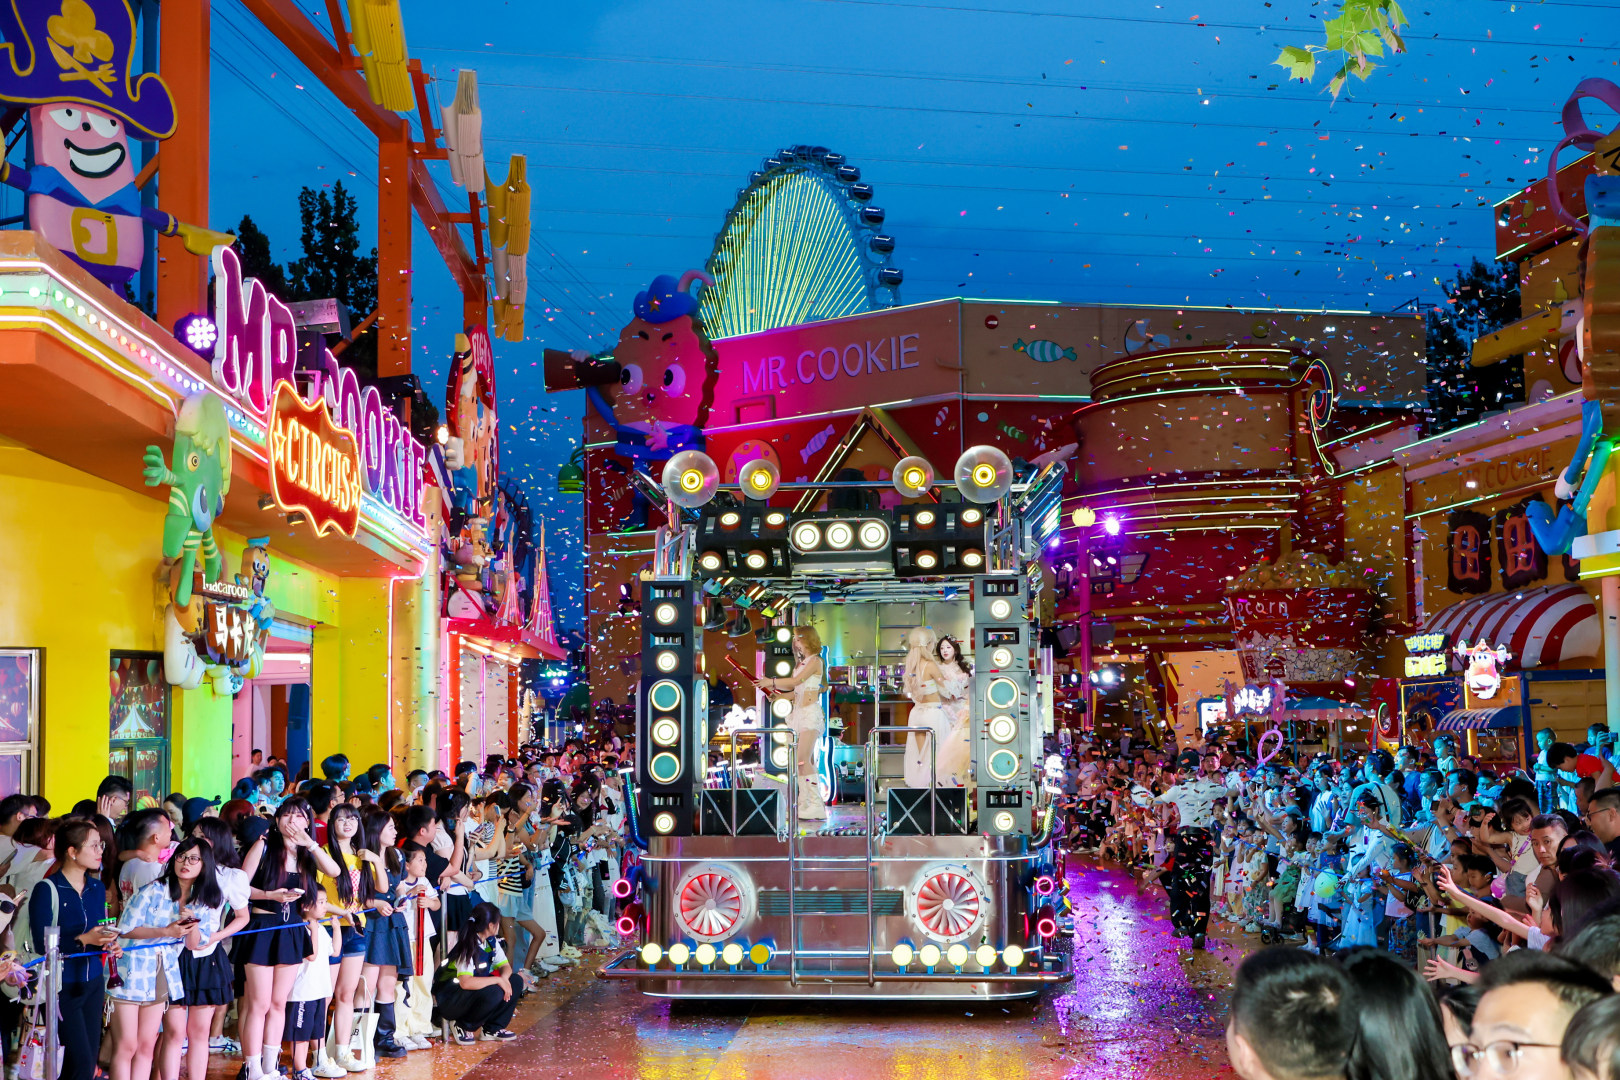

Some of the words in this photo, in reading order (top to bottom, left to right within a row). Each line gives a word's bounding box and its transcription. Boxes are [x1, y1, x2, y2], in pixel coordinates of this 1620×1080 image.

[742, 333, 920, 395] MR.COOKIE
[285, 418, 352, 512] CIRCUS
[214, 606, 255, 660] 马卡龙
